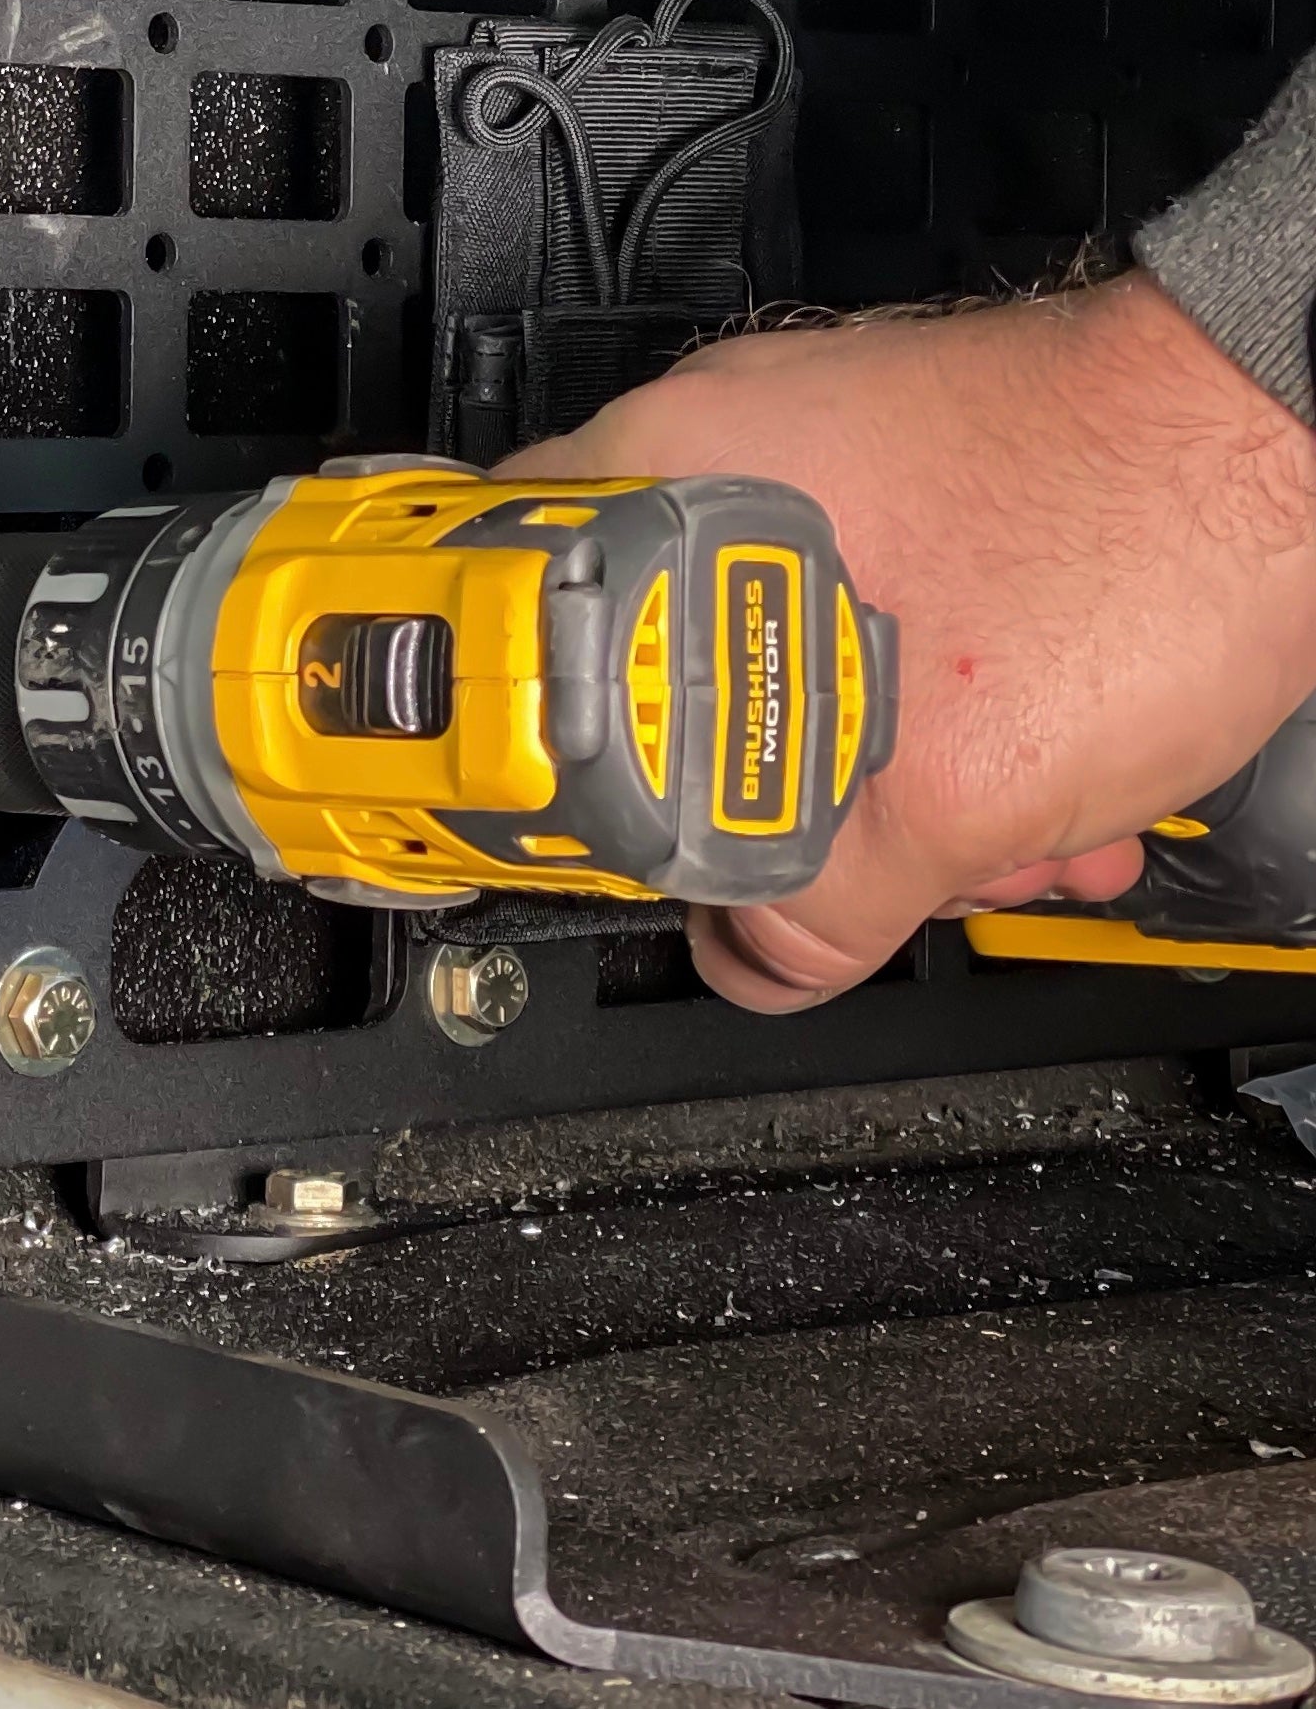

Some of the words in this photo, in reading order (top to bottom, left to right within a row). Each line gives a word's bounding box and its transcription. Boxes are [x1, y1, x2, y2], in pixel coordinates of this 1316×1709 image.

[118, 635, 150, 696] 15
[303, 661, 342, 689] 2
[741, 579, 765, 801] BRUSHLESS
[762, 619, 781, 763] MOTOR
[135, 754, 176, 805] 13
